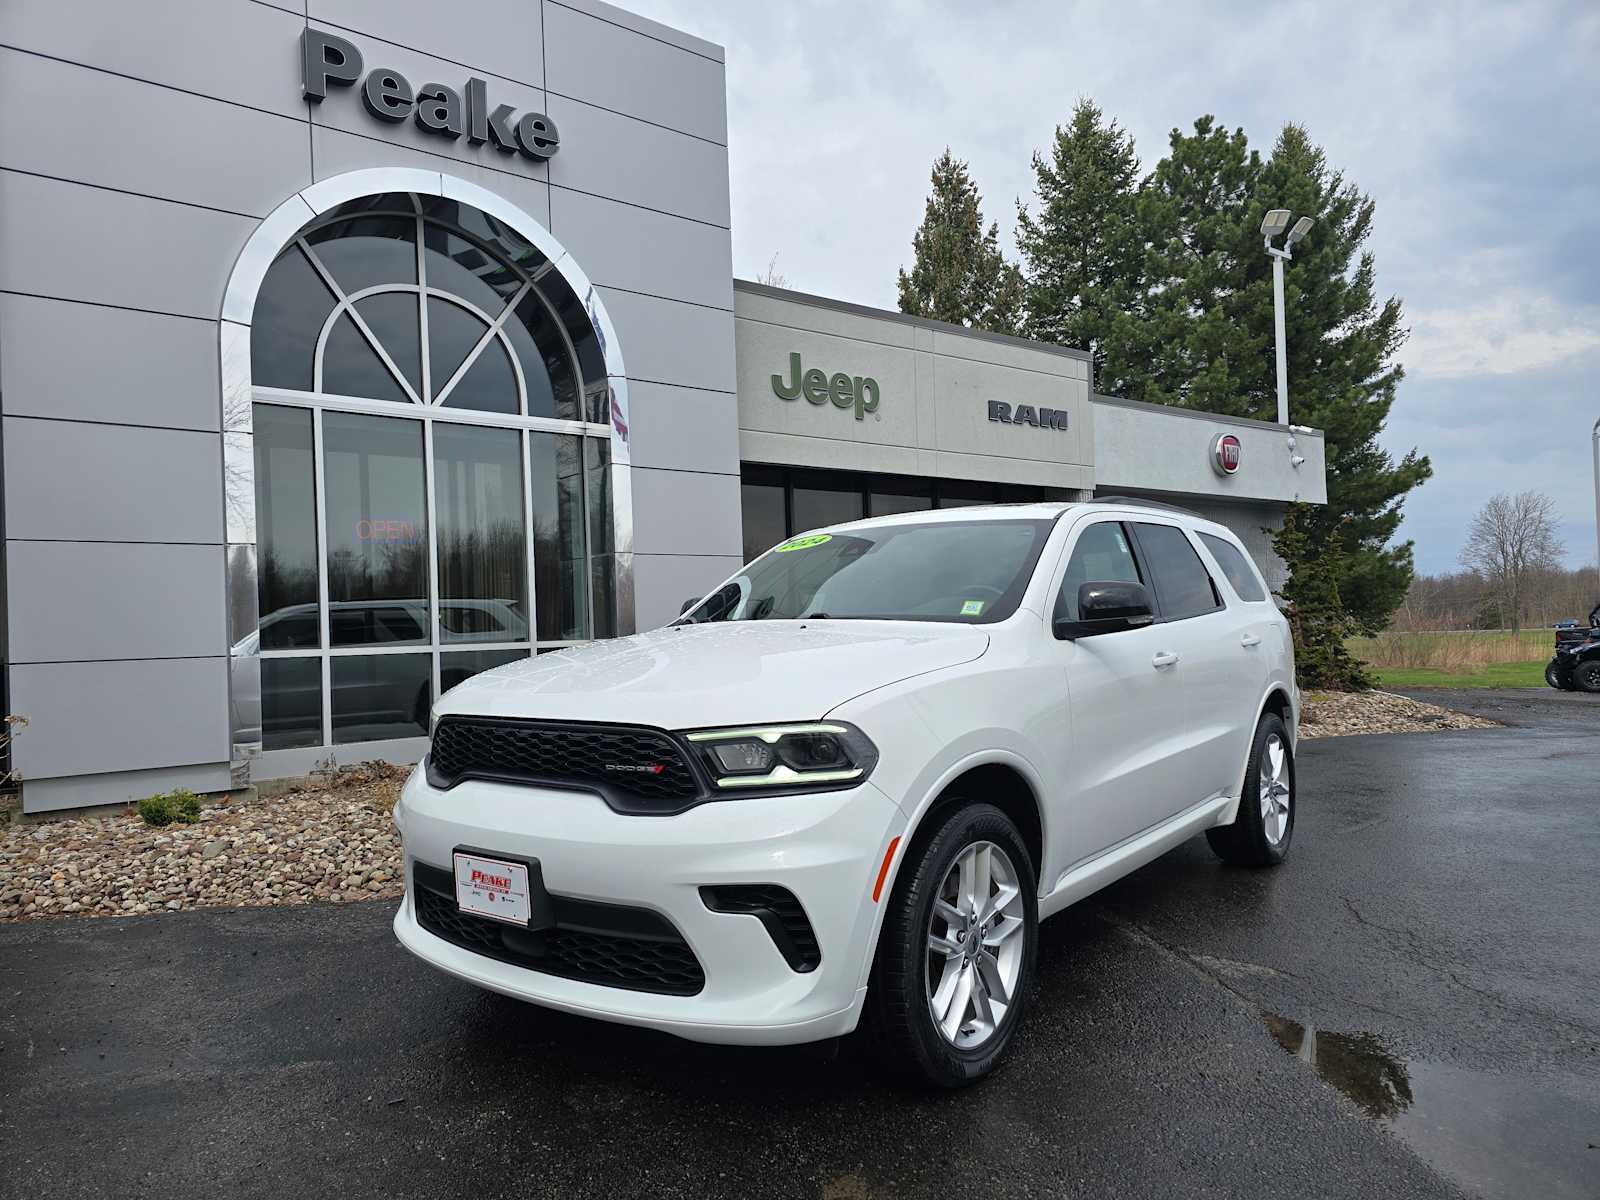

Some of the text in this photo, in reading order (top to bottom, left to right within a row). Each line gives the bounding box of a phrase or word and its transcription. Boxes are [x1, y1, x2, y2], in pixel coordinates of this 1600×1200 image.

[301, 27, 560, 162] Peake
[771, 352, 880, 420] Jeep
[988, 400, 1068, 430] RAM
[355, 519, 416, 540] OPEN
